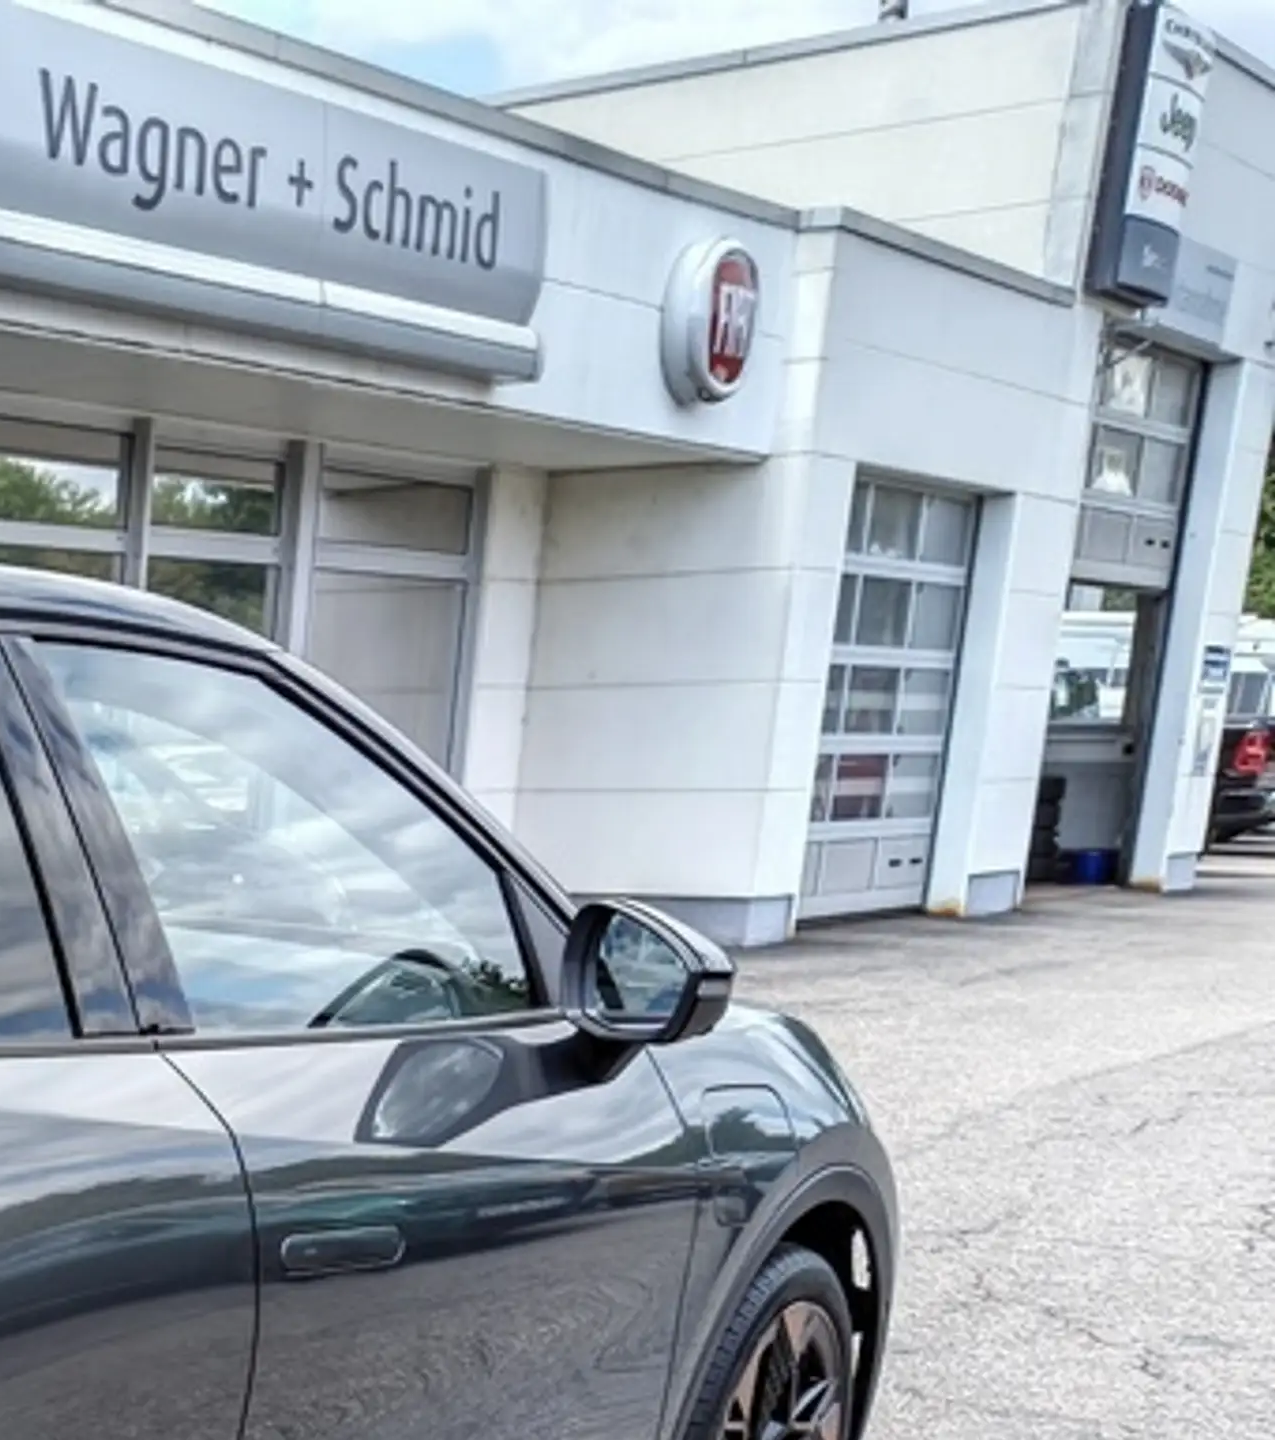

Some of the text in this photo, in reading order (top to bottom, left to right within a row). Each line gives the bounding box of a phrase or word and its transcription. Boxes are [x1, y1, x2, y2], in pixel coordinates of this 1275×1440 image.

[39, 66, 499, 270] Wagner + Schmid
